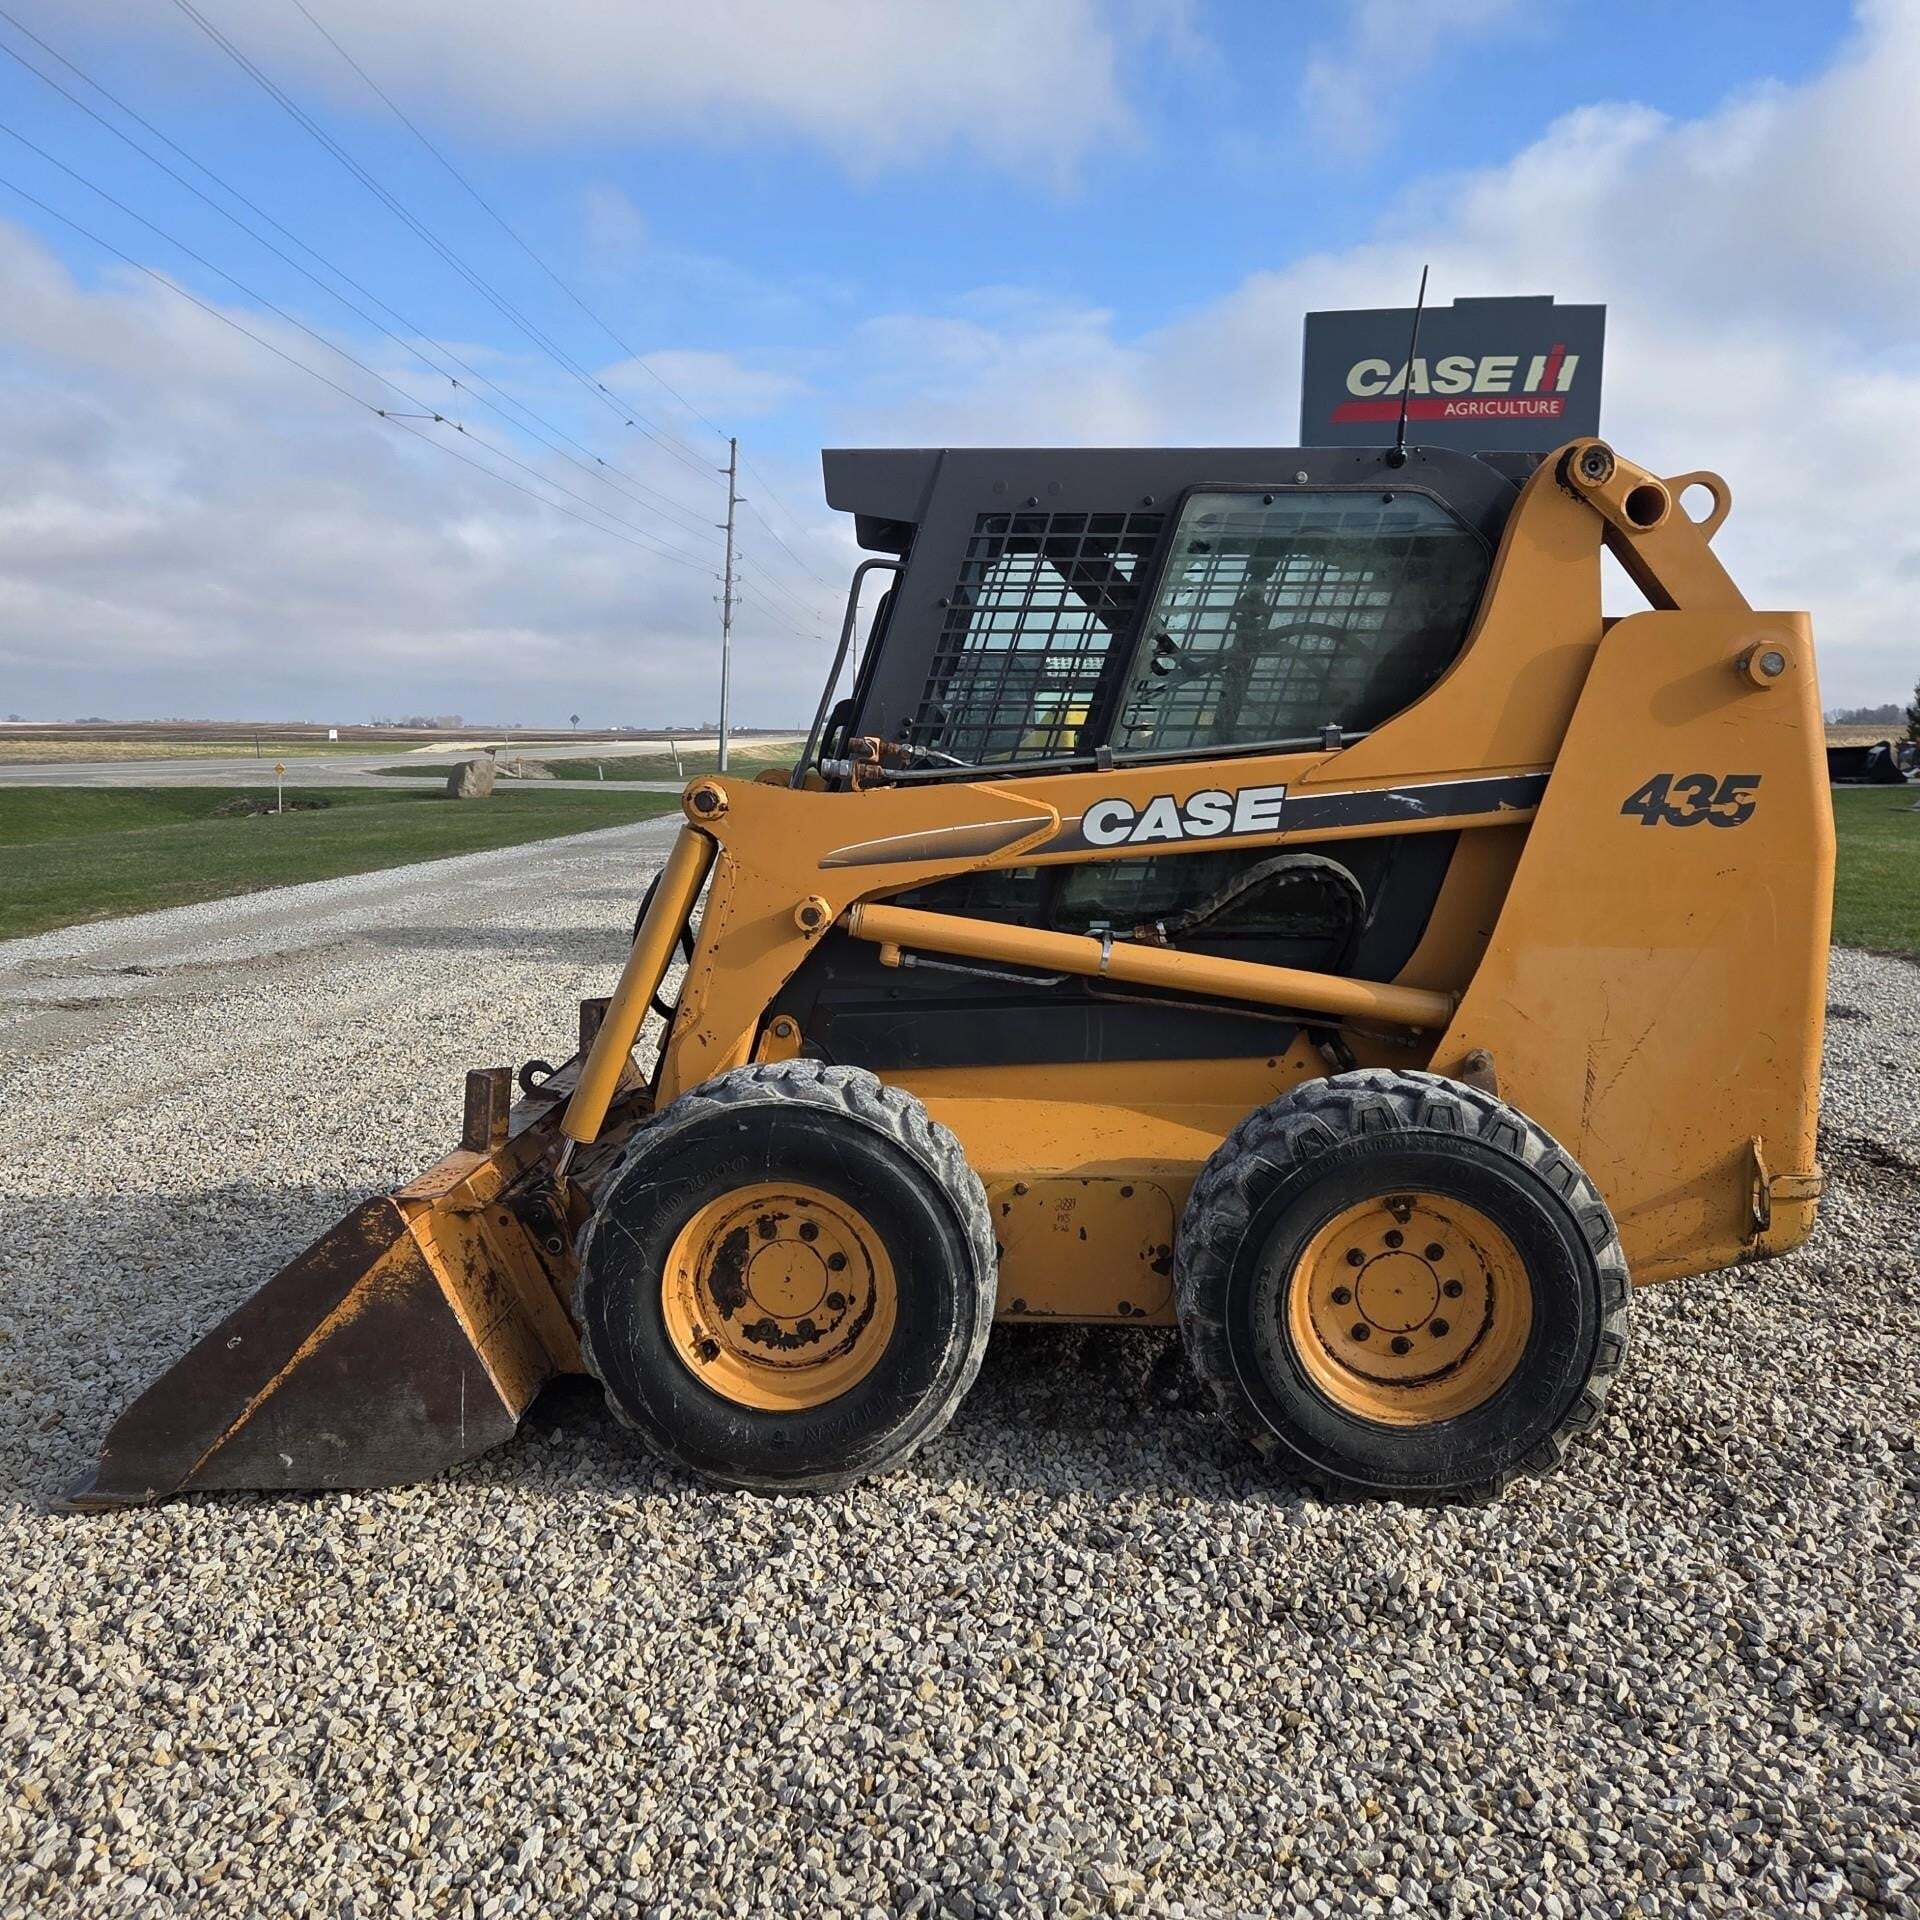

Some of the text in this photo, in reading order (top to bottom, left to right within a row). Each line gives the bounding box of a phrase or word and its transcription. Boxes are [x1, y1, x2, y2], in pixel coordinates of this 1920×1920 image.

[1346, 355, 1519, 397] CASE
[1444, 400, 1560, 416] AGRICULTURE
[1082, 784, 1287, 846] CASE
[1620, 773, 1762, 828] 435
